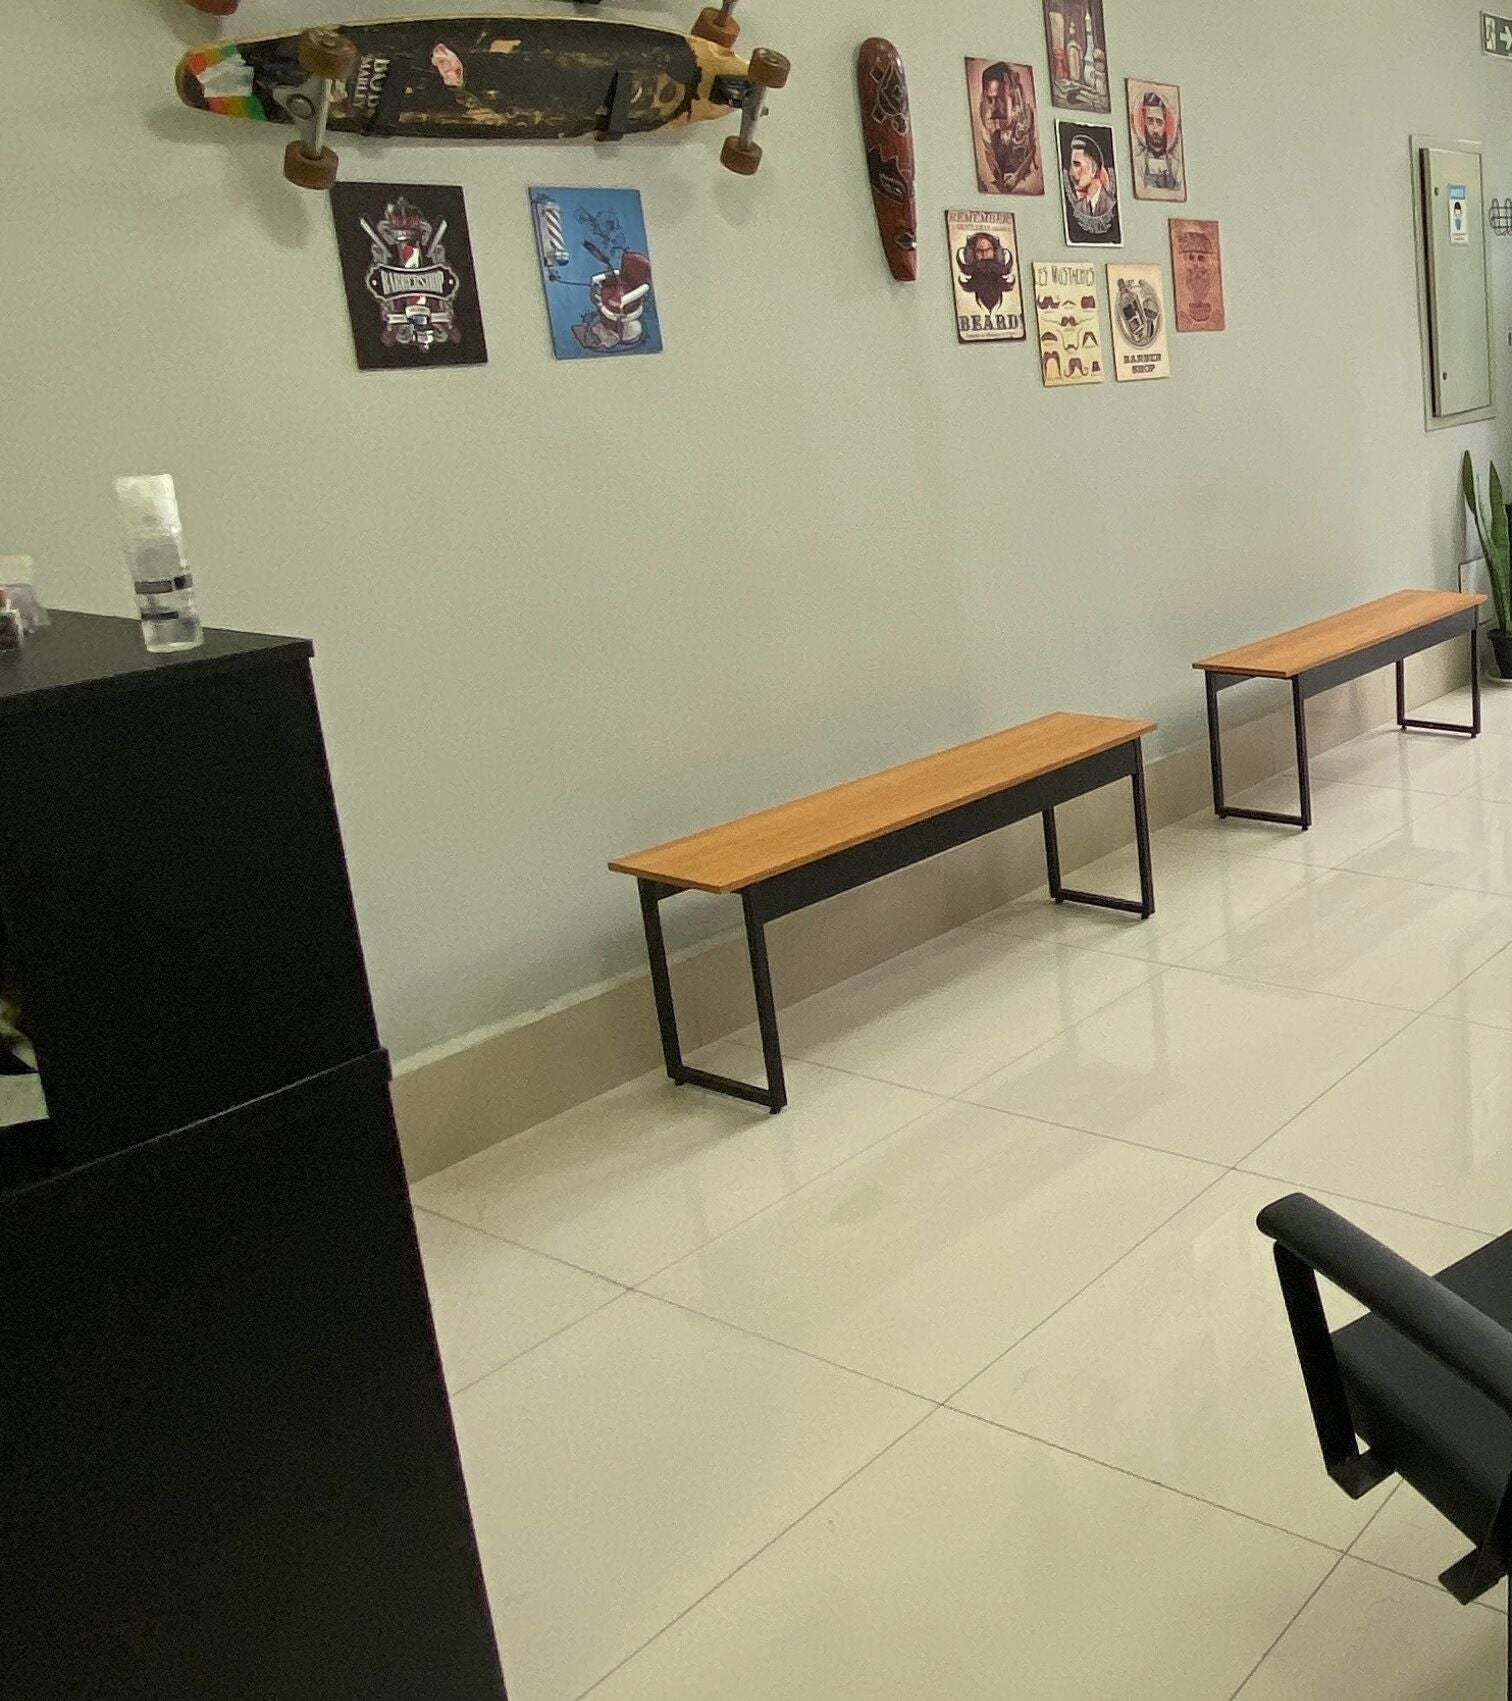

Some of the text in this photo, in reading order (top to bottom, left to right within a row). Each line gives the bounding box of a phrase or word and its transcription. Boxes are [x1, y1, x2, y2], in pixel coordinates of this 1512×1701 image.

[959, 314, 1019, 331] BEARD
[1123, 353, 1162, 363] BARBER
[1132, 364, 1155, 373] SHOP
